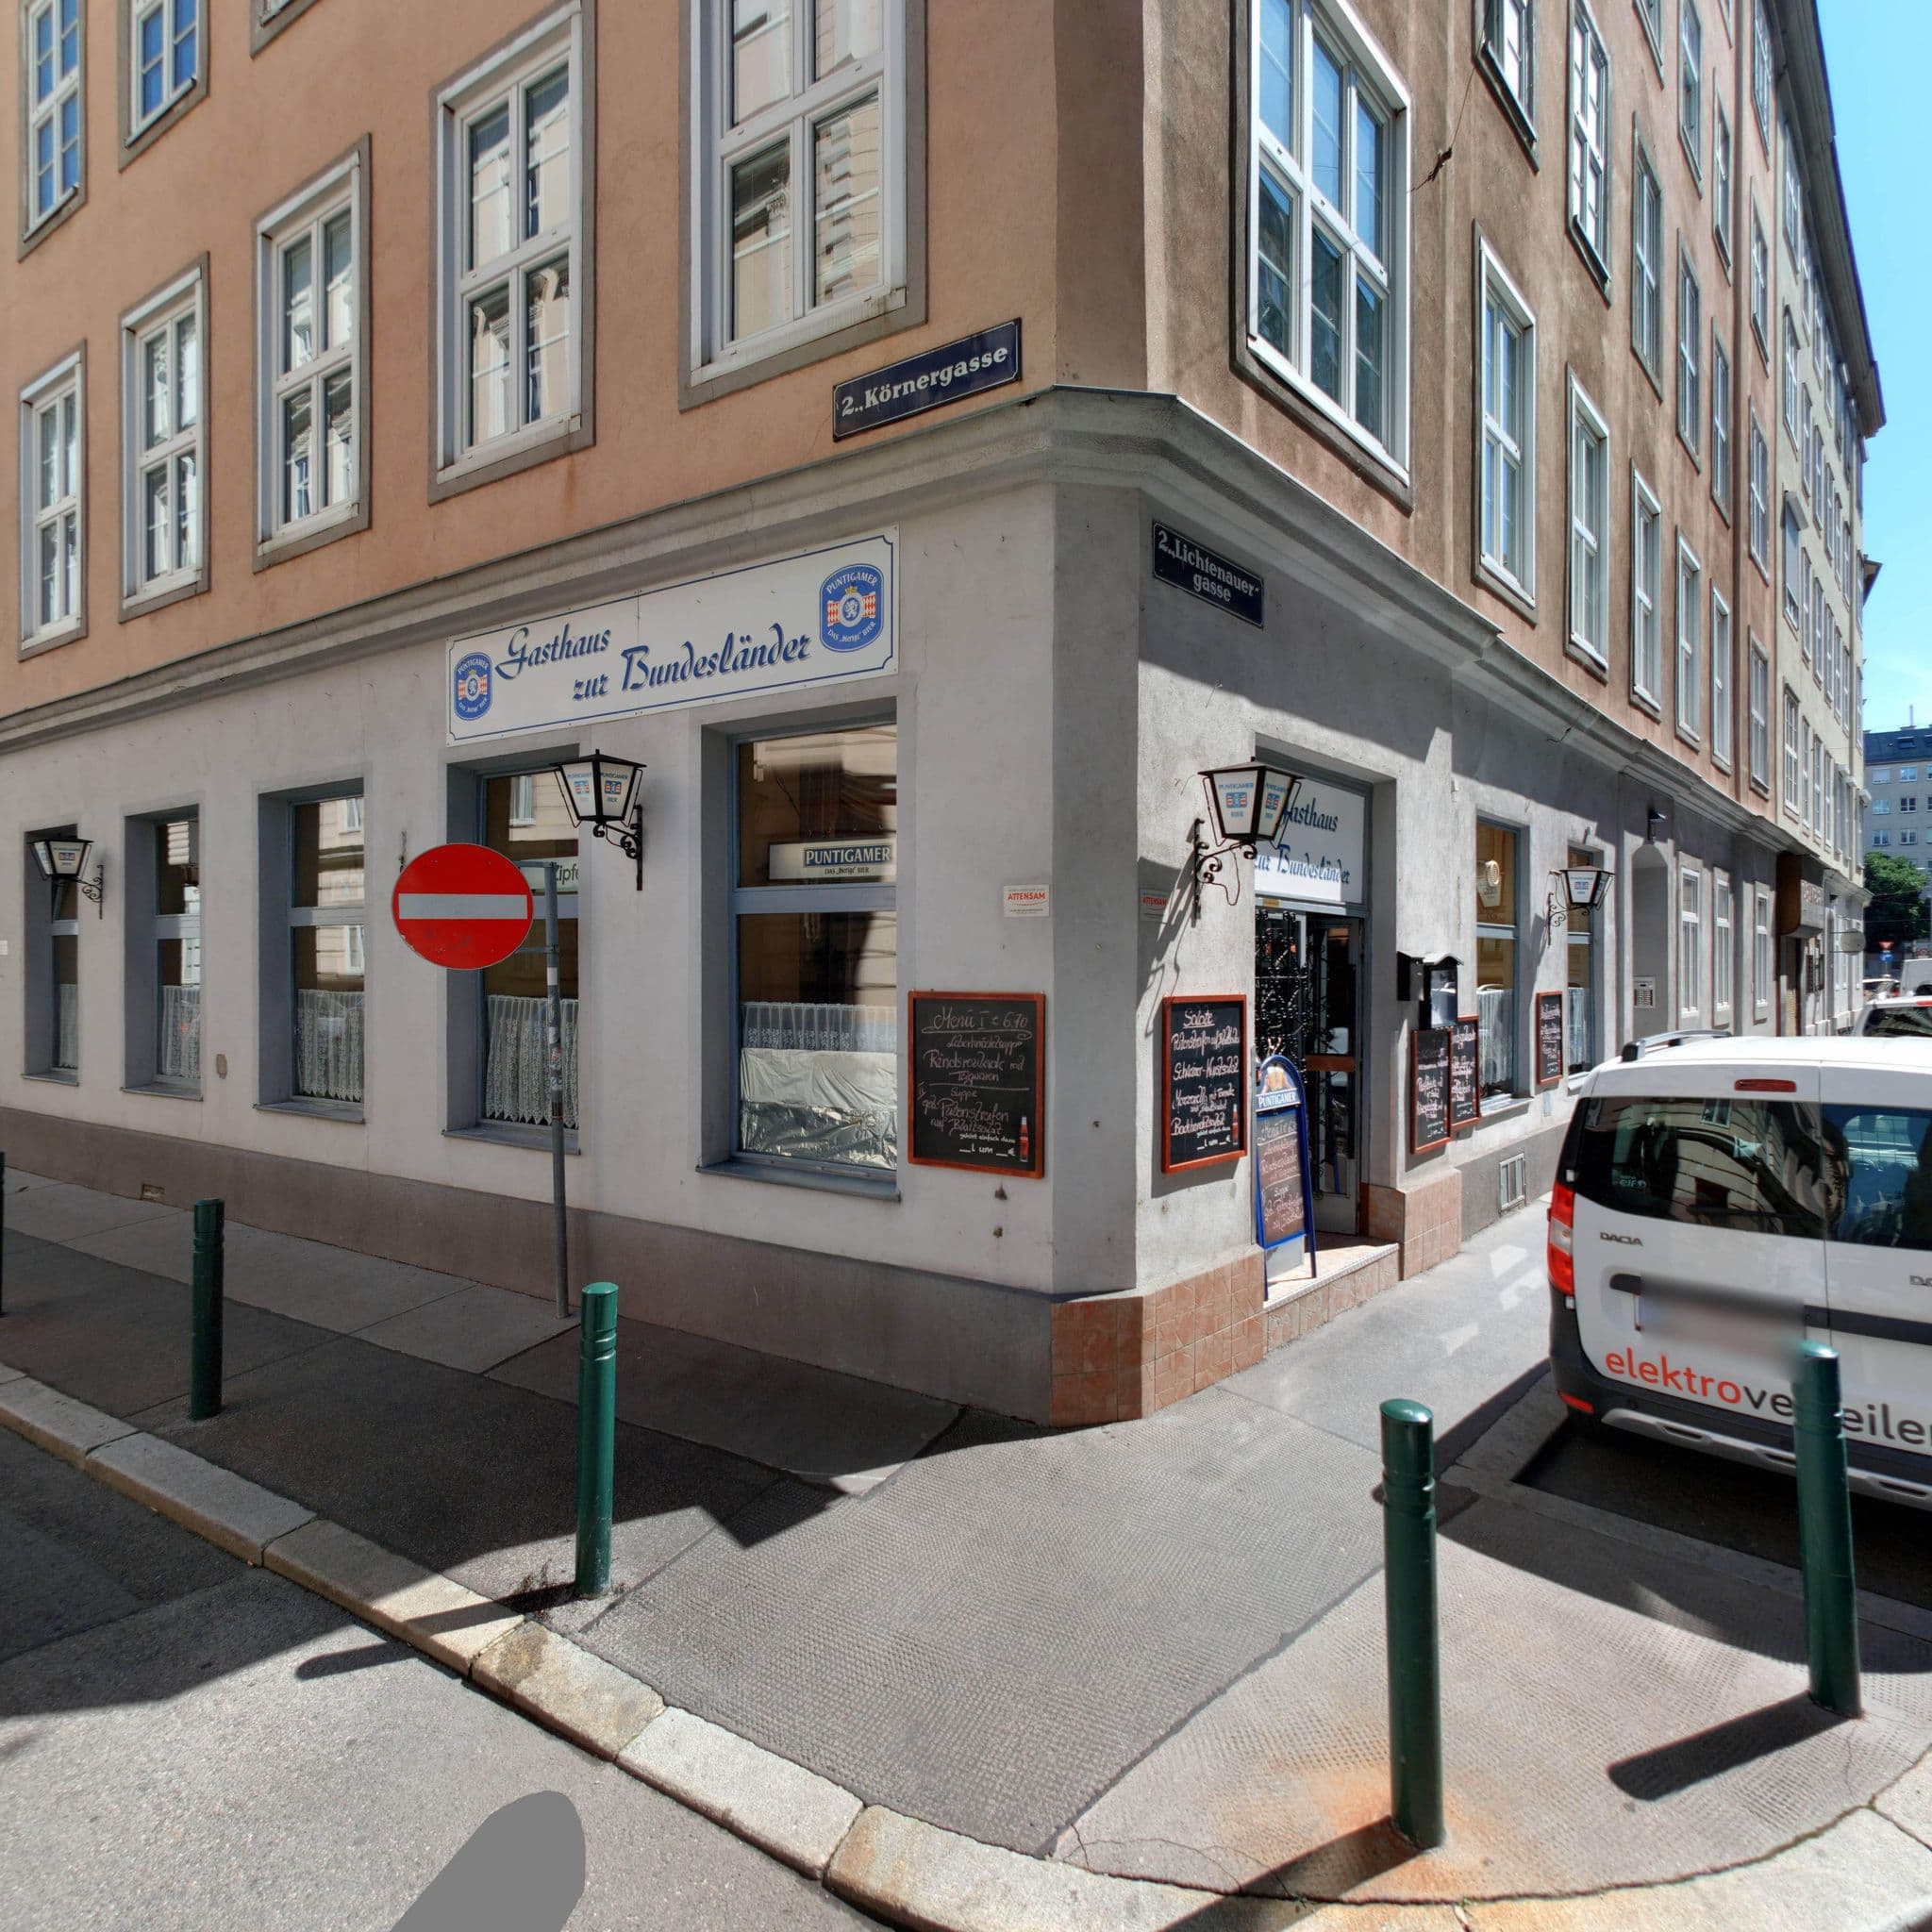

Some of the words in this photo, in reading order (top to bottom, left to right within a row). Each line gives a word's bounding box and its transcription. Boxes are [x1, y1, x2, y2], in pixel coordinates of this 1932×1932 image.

[864, 346, 1008, 409] Körnergasse
[1174, 539, 1259, 597] Lichtenauer-
[826, 571, 877, 594] PUNTIGAMER
[1192, 573, 1231, 603] gasse
[494, 623, 612, 680] Gasthaus
[572, 673, 609, 700] zur
[620, 623, 812, 691] Bundesländer
[806, 846, 891, 866] PUNTIGAMER
[1277, 843, 1351, 884] Bundesländer
[1008, 891, 1046, 901] ATTENSAM
[932, 1006, 975, 1030] Menü
[1183, 1009, 1214, 1027] Salate
[950, 1087, 978, 1102] Suppe
[1257, 1091, 1296, 1108] PUNTIGAMER
[1599, 1231, 1644, 1247] DACIA
